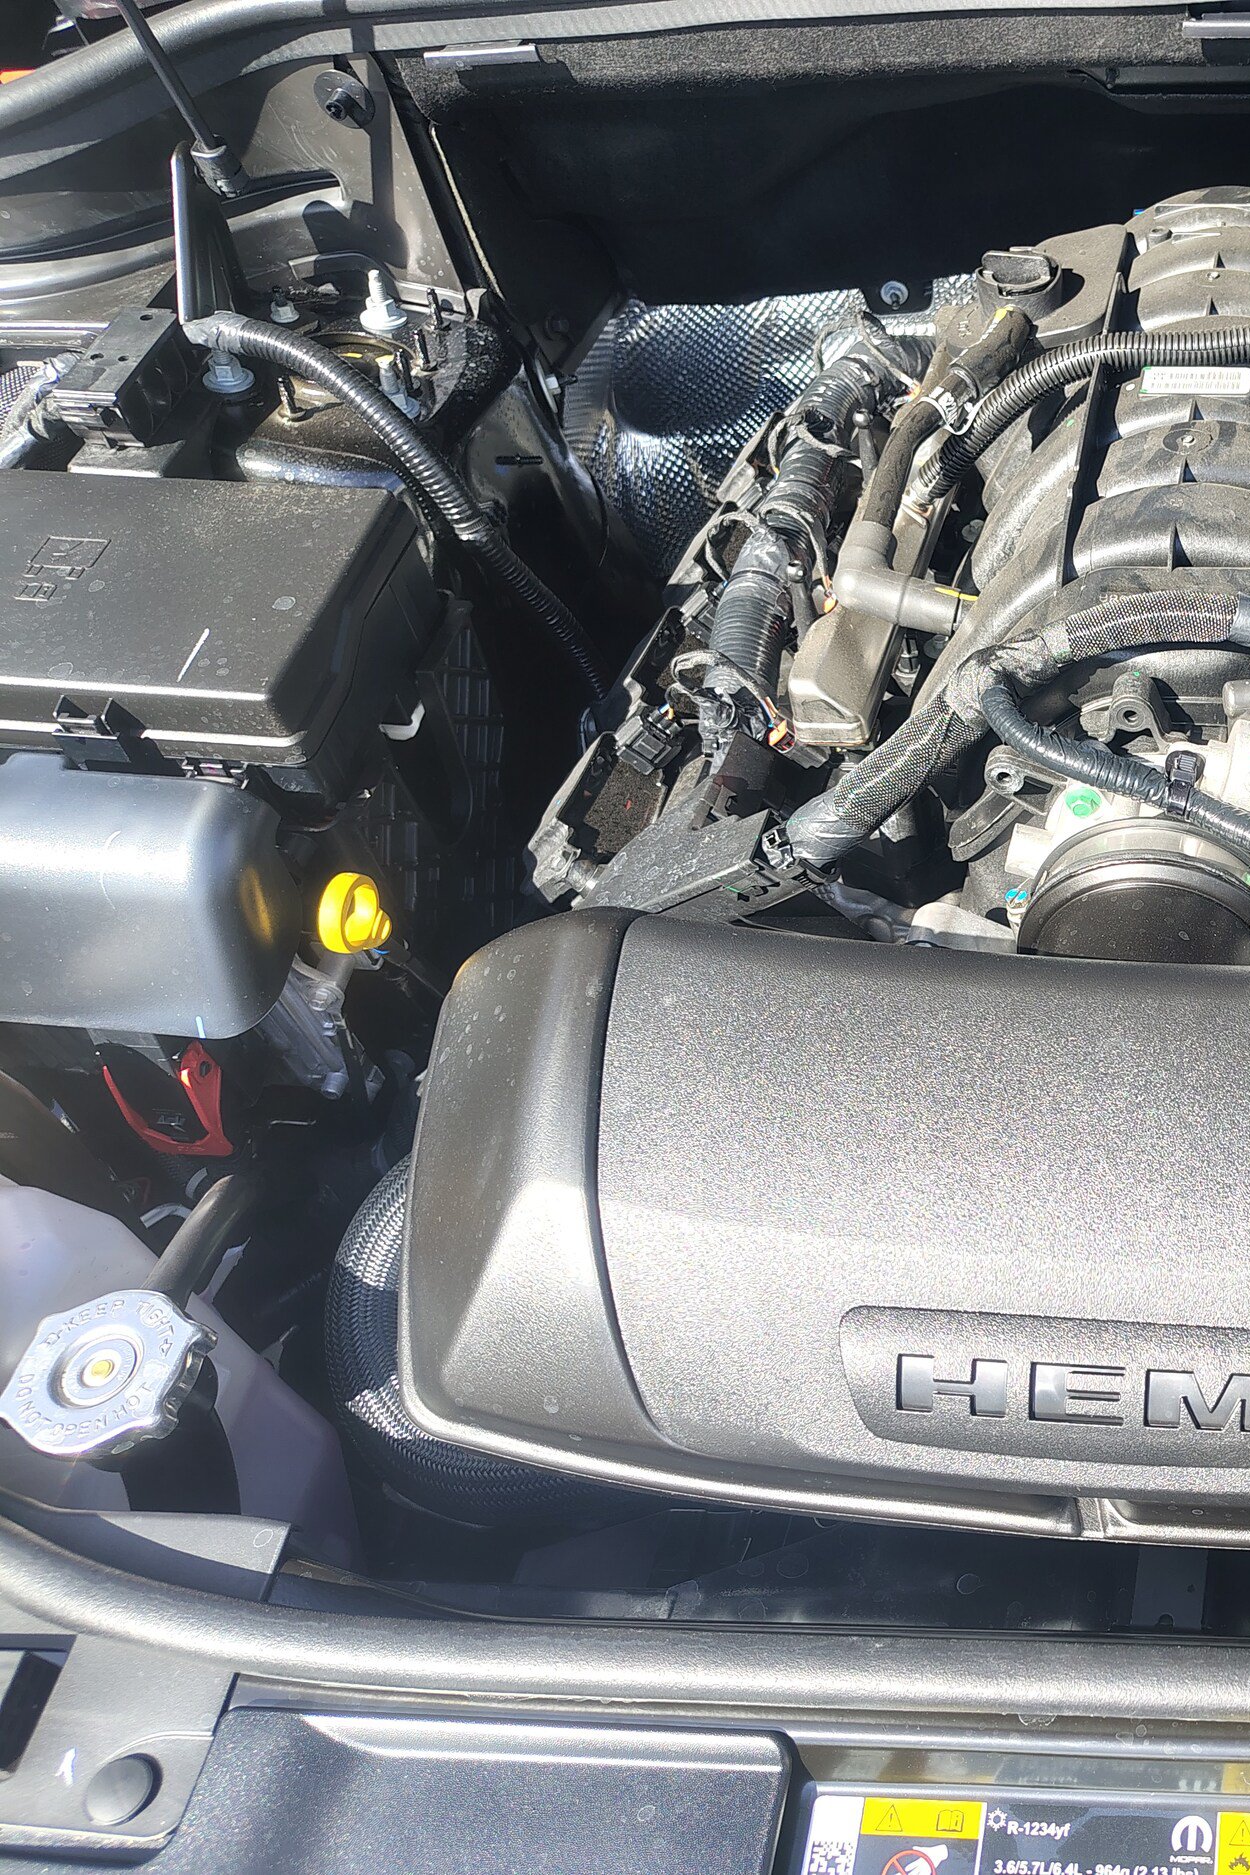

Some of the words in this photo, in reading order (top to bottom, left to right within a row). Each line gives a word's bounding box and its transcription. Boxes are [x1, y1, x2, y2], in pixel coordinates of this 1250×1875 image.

[63, 1299, 125, 1331] KEEP
[135, 1300, 175, 1338] TIGHT
[15, 1373, 35, 1398] DO
[50, 1415, 108, 1438] OPEN
[112, 1381, 152, 1420] HOT
[1006, 1820, 1071, 1840] R-1234yf
[993, 1859, 1083, 1875] 3.6/5.7L/6.4L
[1133, 1865, 1169, 1875] (213
